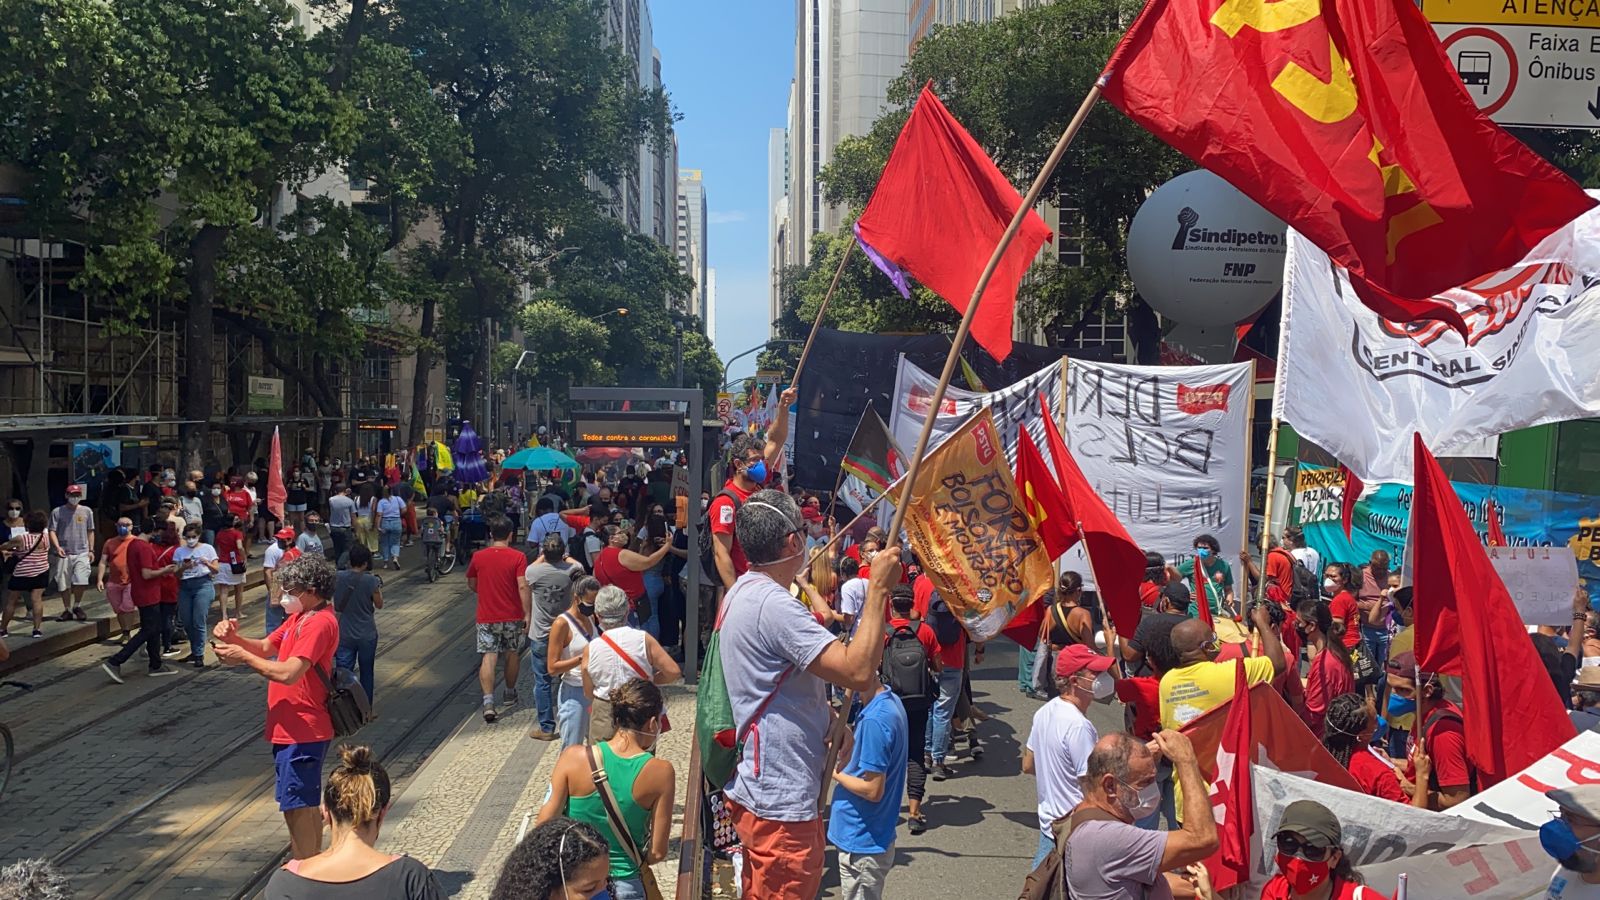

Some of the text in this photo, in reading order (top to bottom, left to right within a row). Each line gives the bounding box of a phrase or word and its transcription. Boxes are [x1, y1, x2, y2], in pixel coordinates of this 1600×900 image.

[1529, 33, 1579, 52] Faixa
[1528, 56, 1595, 81] Ônibus
[1189, 228, 1278, 246] Sindipetro
[1223, 262, 1256, 277] FNP
[1363, 345, 1481, 378] CENTRAL
[583, 434, 602, 442] Todos
[606, 434, 628, 442] contra
[976, 426, 993, 459] PSTU
[933, 502, 954, 521] E
[965, 468, 1039, 568] FORA
[940, 470, 1024, 595] BOLSONARO
[1368, 512, 1403, 538] CONTRA
[942, 518, 999, 588] MOURÃO
